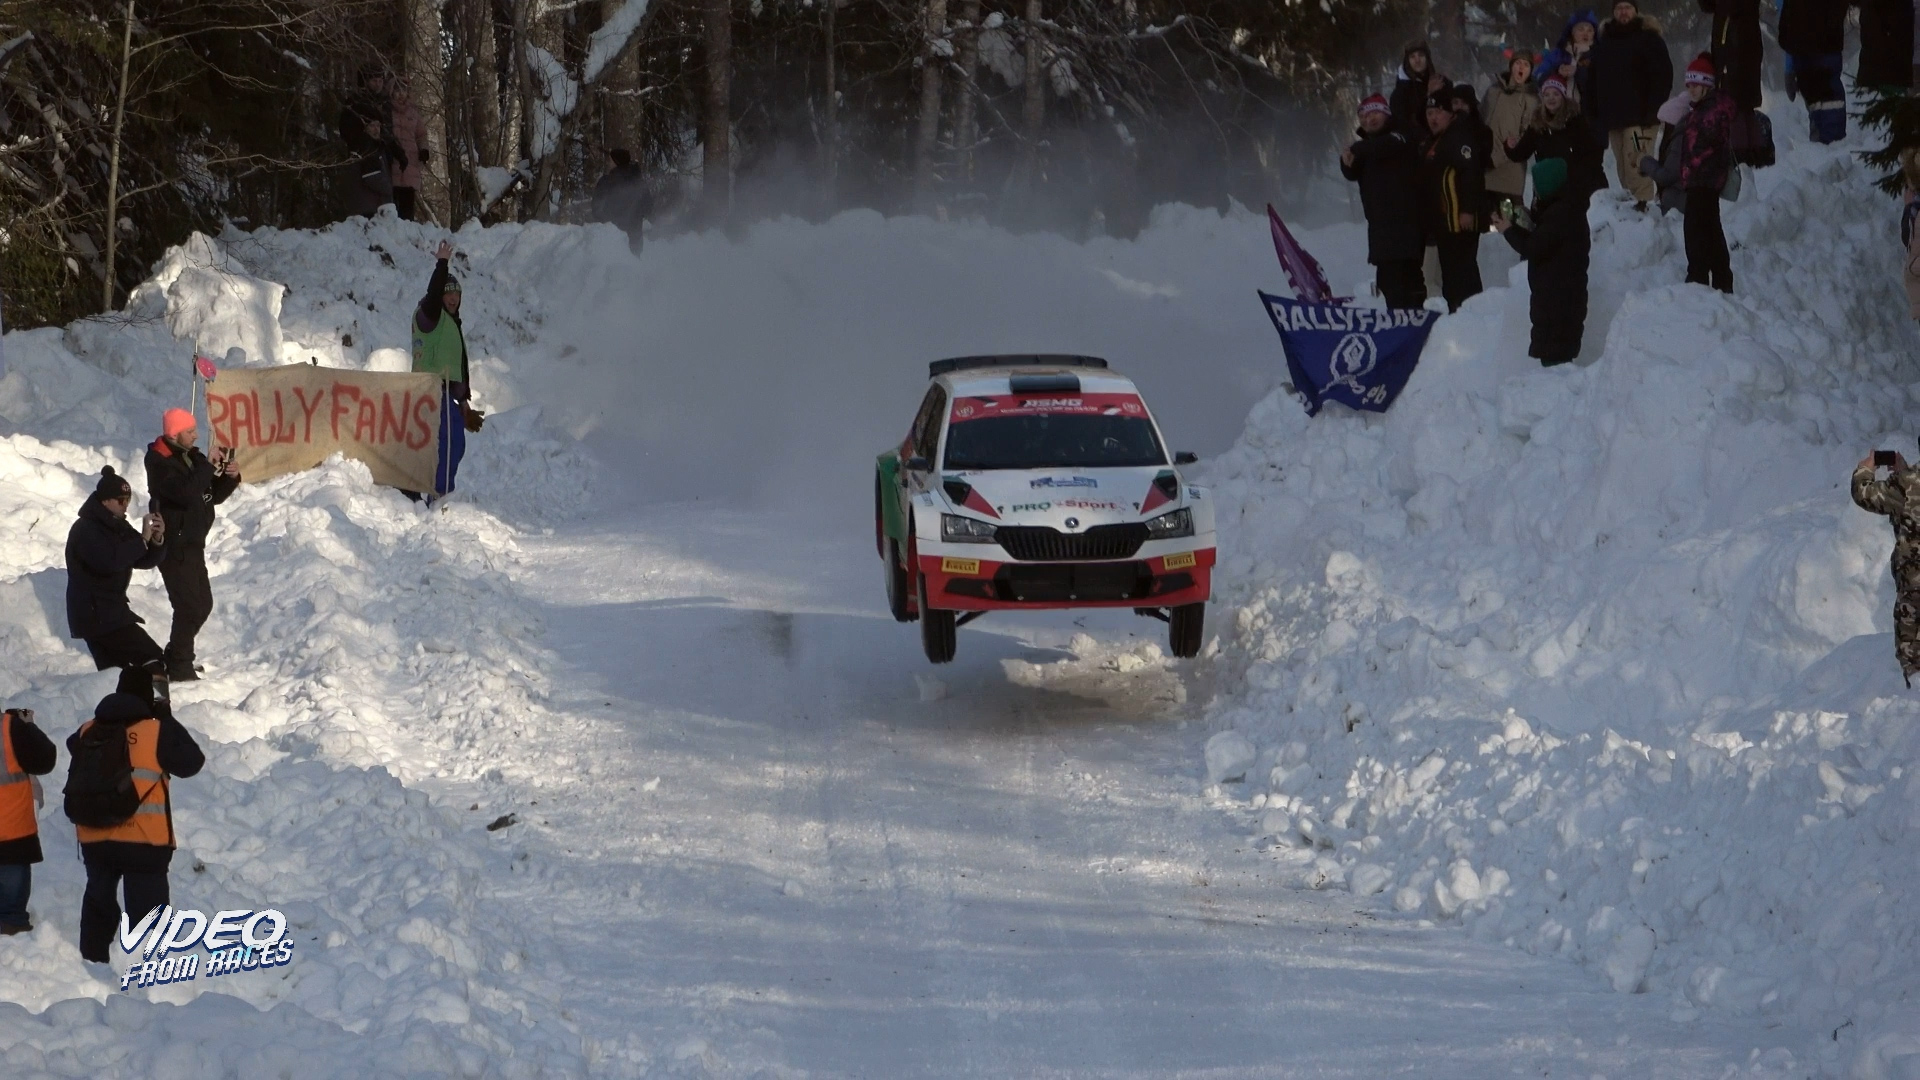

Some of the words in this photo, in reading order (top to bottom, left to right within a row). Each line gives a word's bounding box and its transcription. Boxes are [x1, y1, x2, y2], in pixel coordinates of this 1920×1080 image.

[207, 387, 324, 448] RALLY
[330, 380, 437, 450] FANS
[1012, 501, 1051, 512] PRO
[946, 560, 976, 571] PIRELLI
[1166, 554, 1192, 567] PIRELLI
